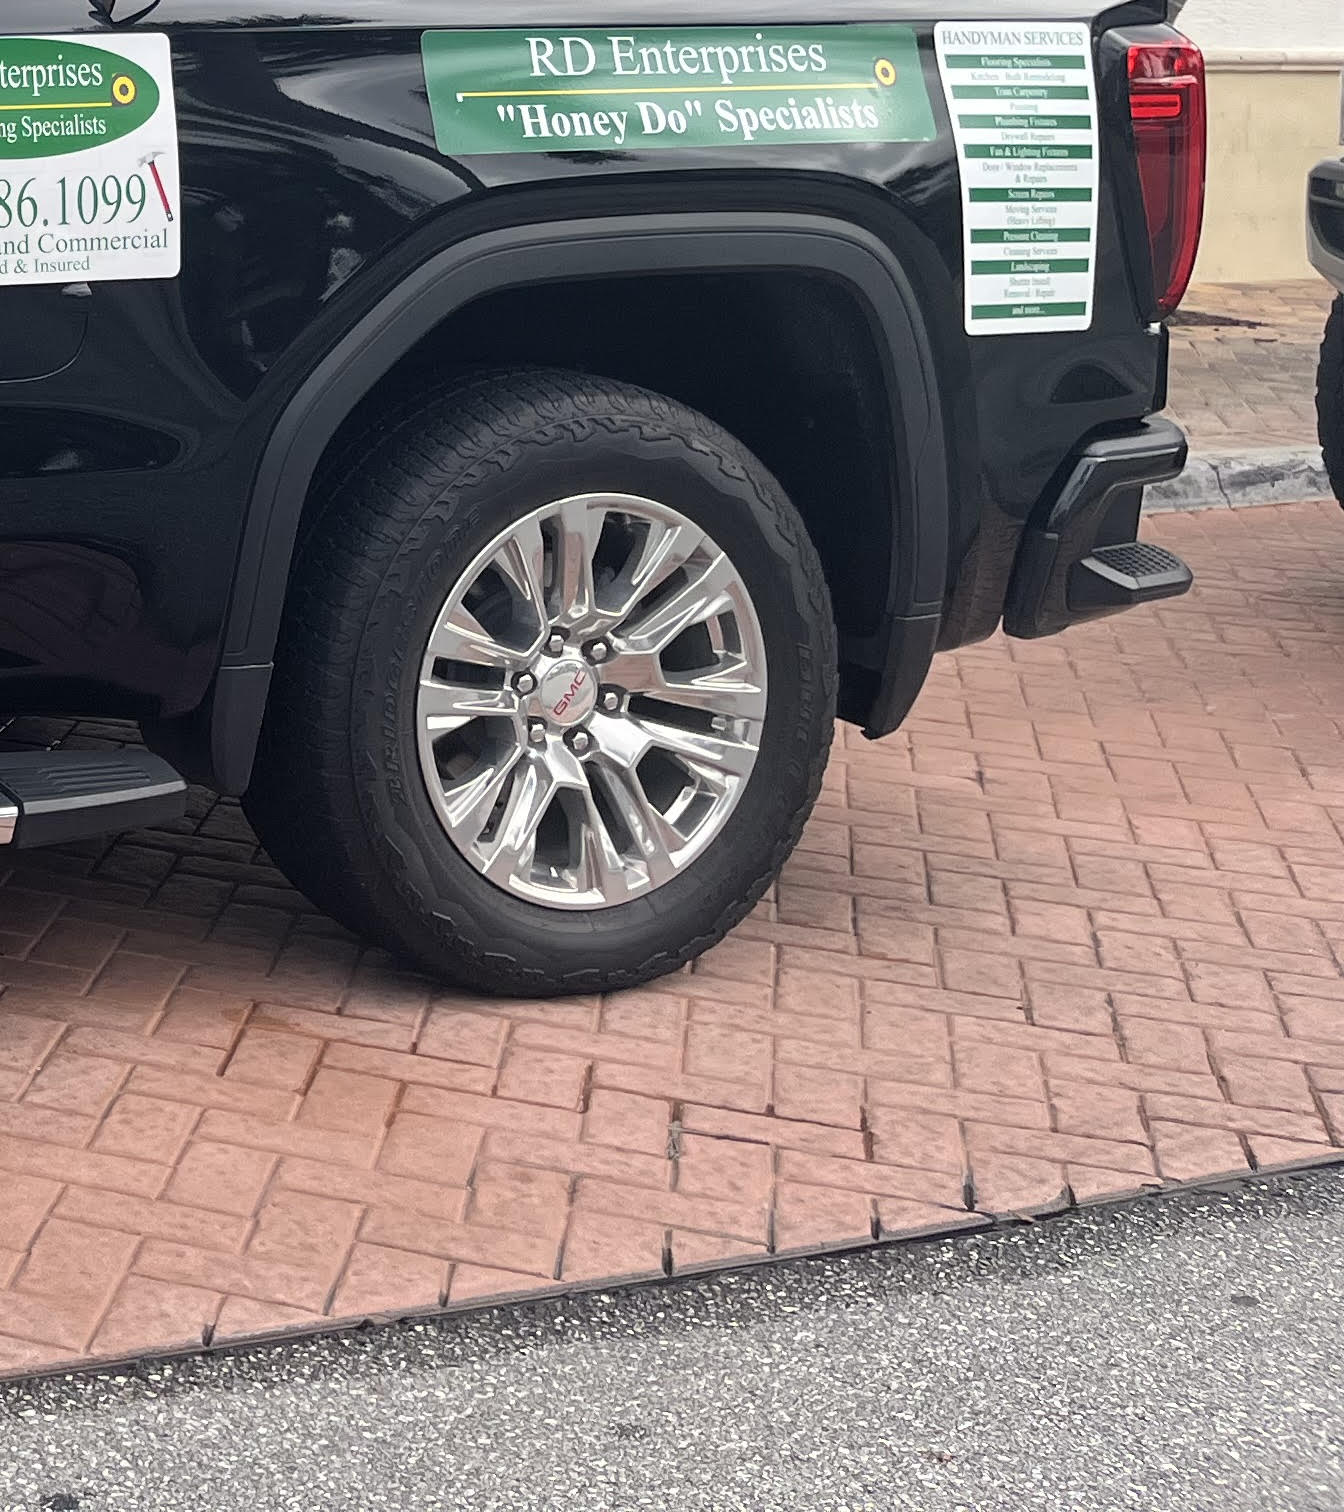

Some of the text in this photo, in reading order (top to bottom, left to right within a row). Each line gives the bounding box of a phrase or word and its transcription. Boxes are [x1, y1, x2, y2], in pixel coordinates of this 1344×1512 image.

[942, 31, 1084, 46] HANDYMAN SERVICES
[525, 32, 828, 85] RD Enterprises
[21, 114, 107, 143] Specialists
[497, 97, 879, 145] "Honey Do" Specialists
[37, 228, 169, 254] Commercial
[13, 259, 29, 274] &
[34, 256, 91, 274] Insured
[553, 668, 587, 716] GMC
